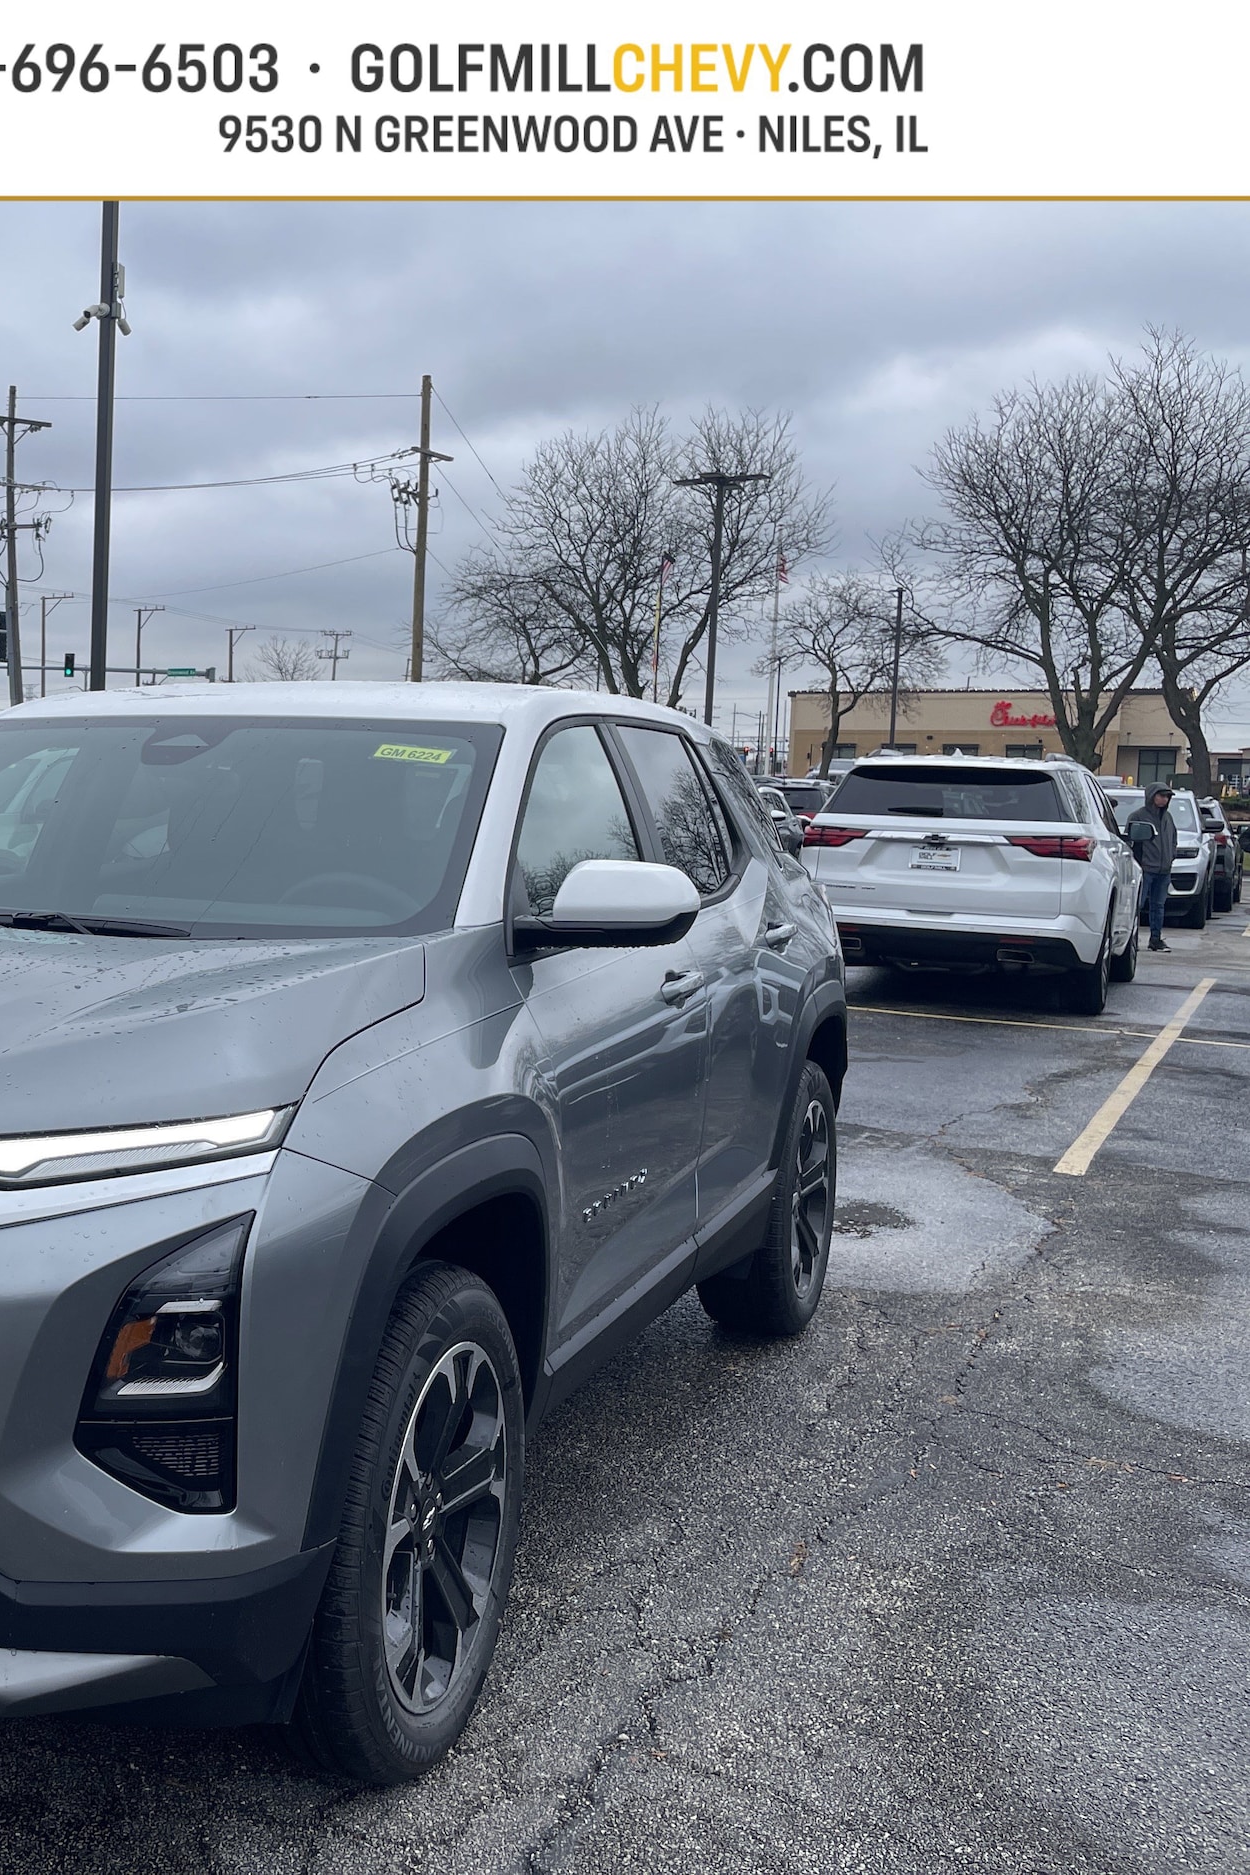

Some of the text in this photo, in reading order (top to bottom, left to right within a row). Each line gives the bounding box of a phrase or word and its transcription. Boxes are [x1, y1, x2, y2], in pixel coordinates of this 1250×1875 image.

[990, 701, 1057, 728] Chick-fil-
[380, 748, 442, 761] GM 6224
